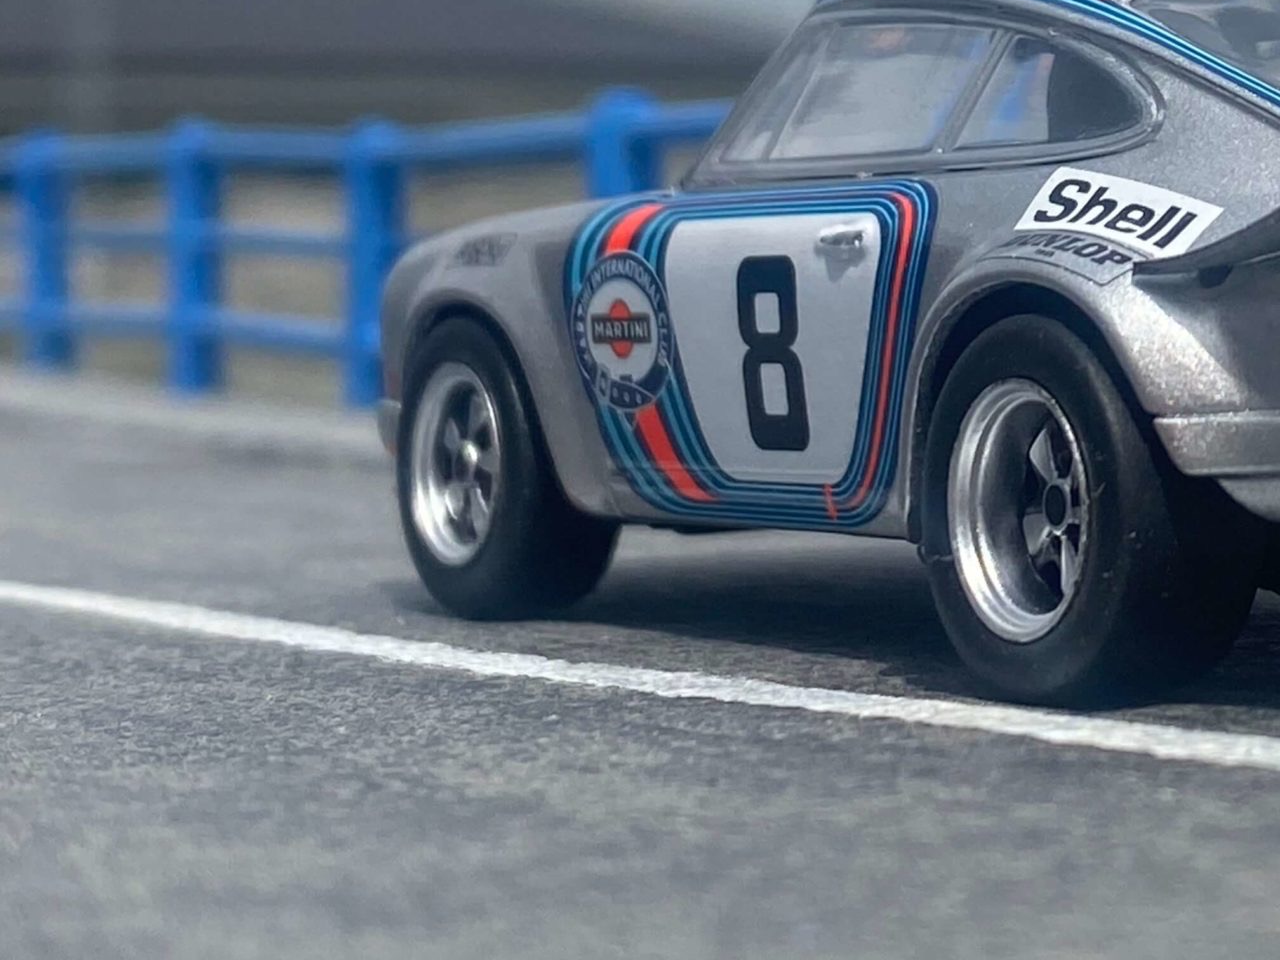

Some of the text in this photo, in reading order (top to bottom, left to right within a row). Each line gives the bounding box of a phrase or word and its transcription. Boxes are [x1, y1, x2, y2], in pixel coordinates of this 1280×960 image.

[1033, 178, 1198, 249] Shell
[590, 258, 660, 307] INTERNATIONAL
[593, 320, 649, 338] MARTINI
[737, 255, 810, 451] 8
